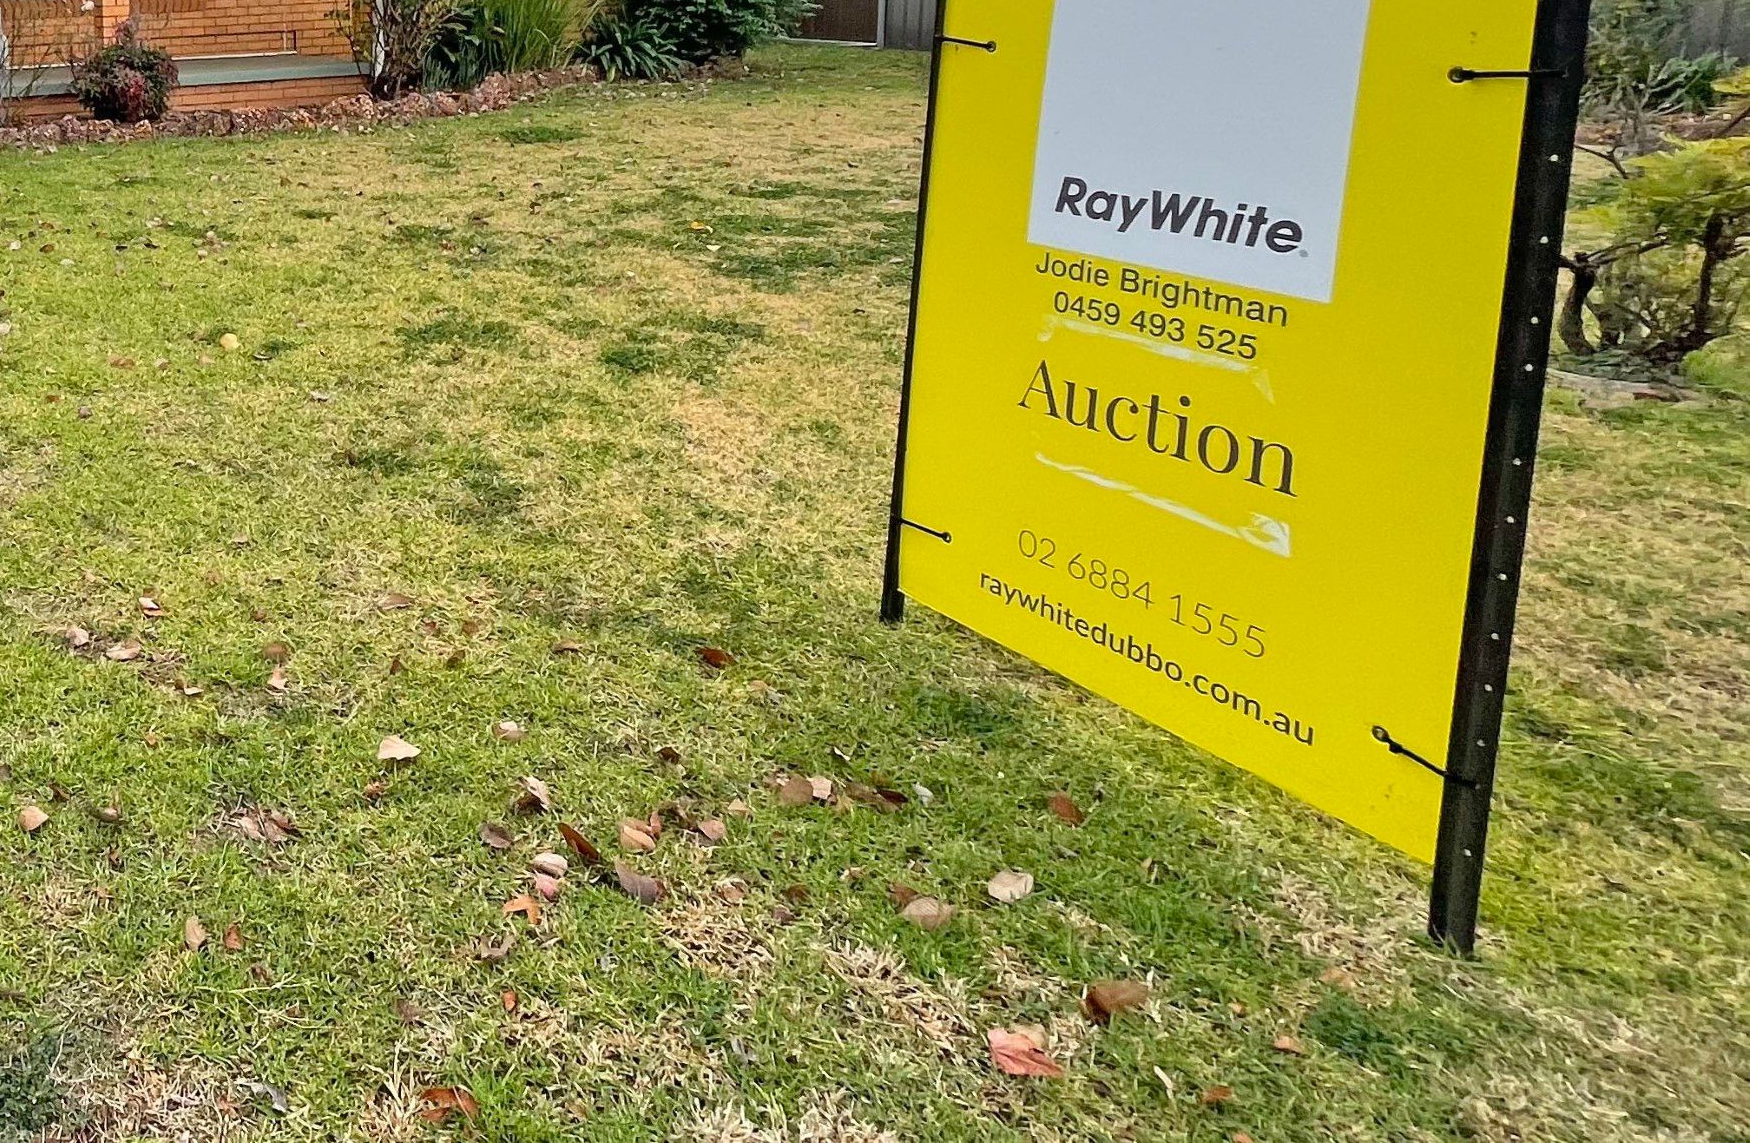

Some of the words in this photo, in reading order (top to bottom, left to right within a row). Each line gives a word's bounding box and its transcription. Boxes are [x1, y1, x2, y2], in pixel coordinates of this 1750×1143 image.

[1054, 175, 1303, 253] RayWhite
[1035, 252, 1110, 287] Jodie
[1119, 267, 1288, 327] Brightman
[1053, 290, 1121, 326] 0459
[1129, 309, 1186, 342] 493
[1196, 323, 1258, 360] 525
[1017, 358, 1299, 498] Auction
[1017, 529, 1057, 569] 02
[1067, 552, 1155, 611] 6884
[1168, 593, 1267, 659] 1555
[979, 571, 1315, 747] raywhitedubbo.com.au
